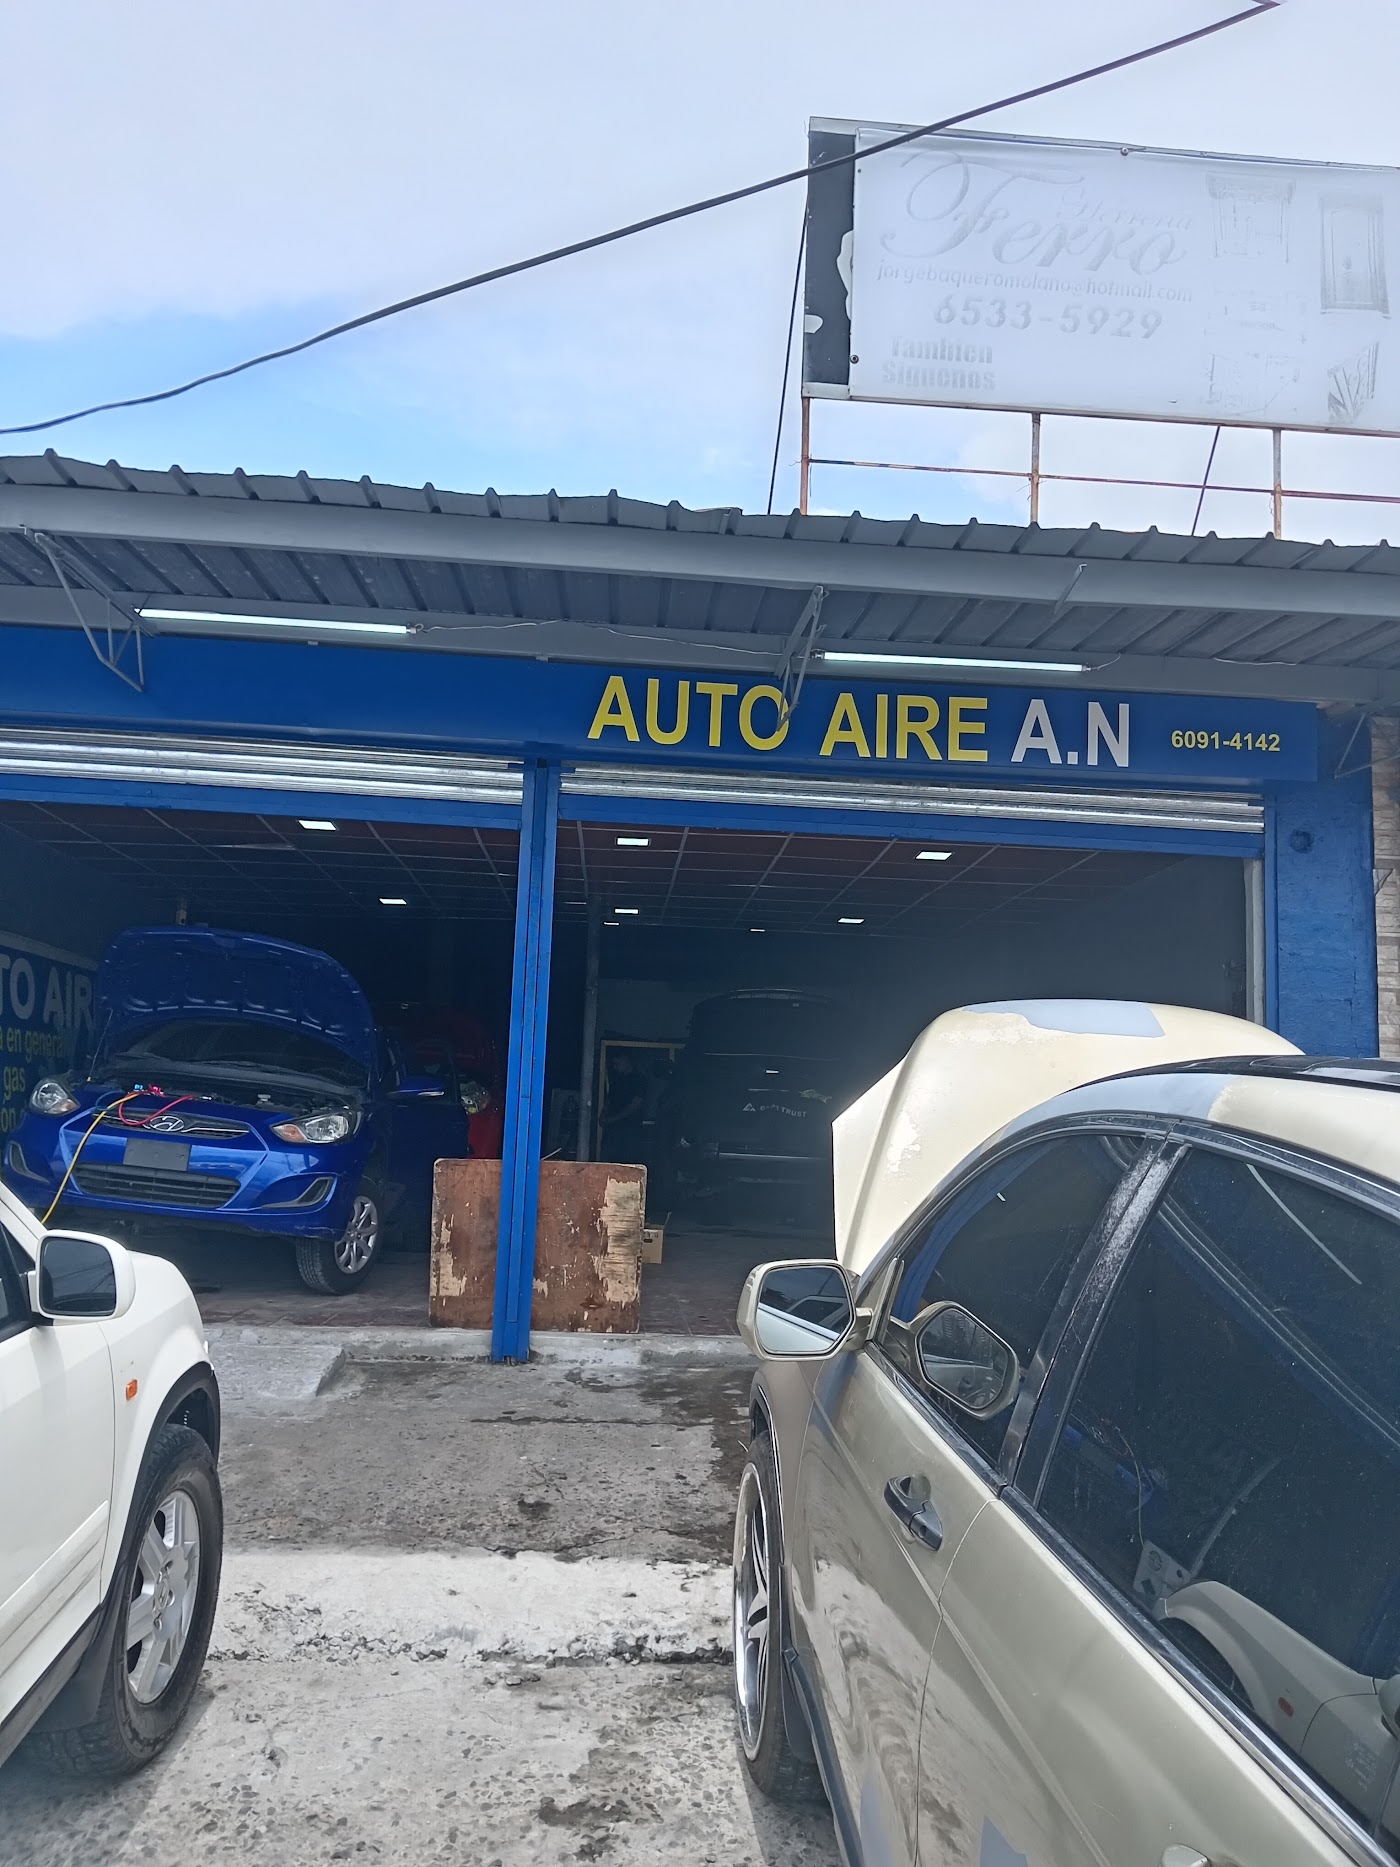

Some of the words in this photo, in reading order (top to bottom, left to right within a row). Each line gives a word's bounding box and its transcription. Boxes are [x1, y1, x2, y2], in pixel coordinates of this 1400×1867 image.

[880, 150, 1188, 276] Ferro
[933, 294, 1162, 339] 6533-5929
[587, 675, 790, 751] AUTO
[818, 692, 989, 762] AIRE
[1010, 698, 1130, 768] A.N
[1171, 729, 1281, 752] 6091-4142
[6, 1027, 21, 1053] en
[25, 1030, 66, 1063] genera
[4, 1066, 26, 1101] gas
